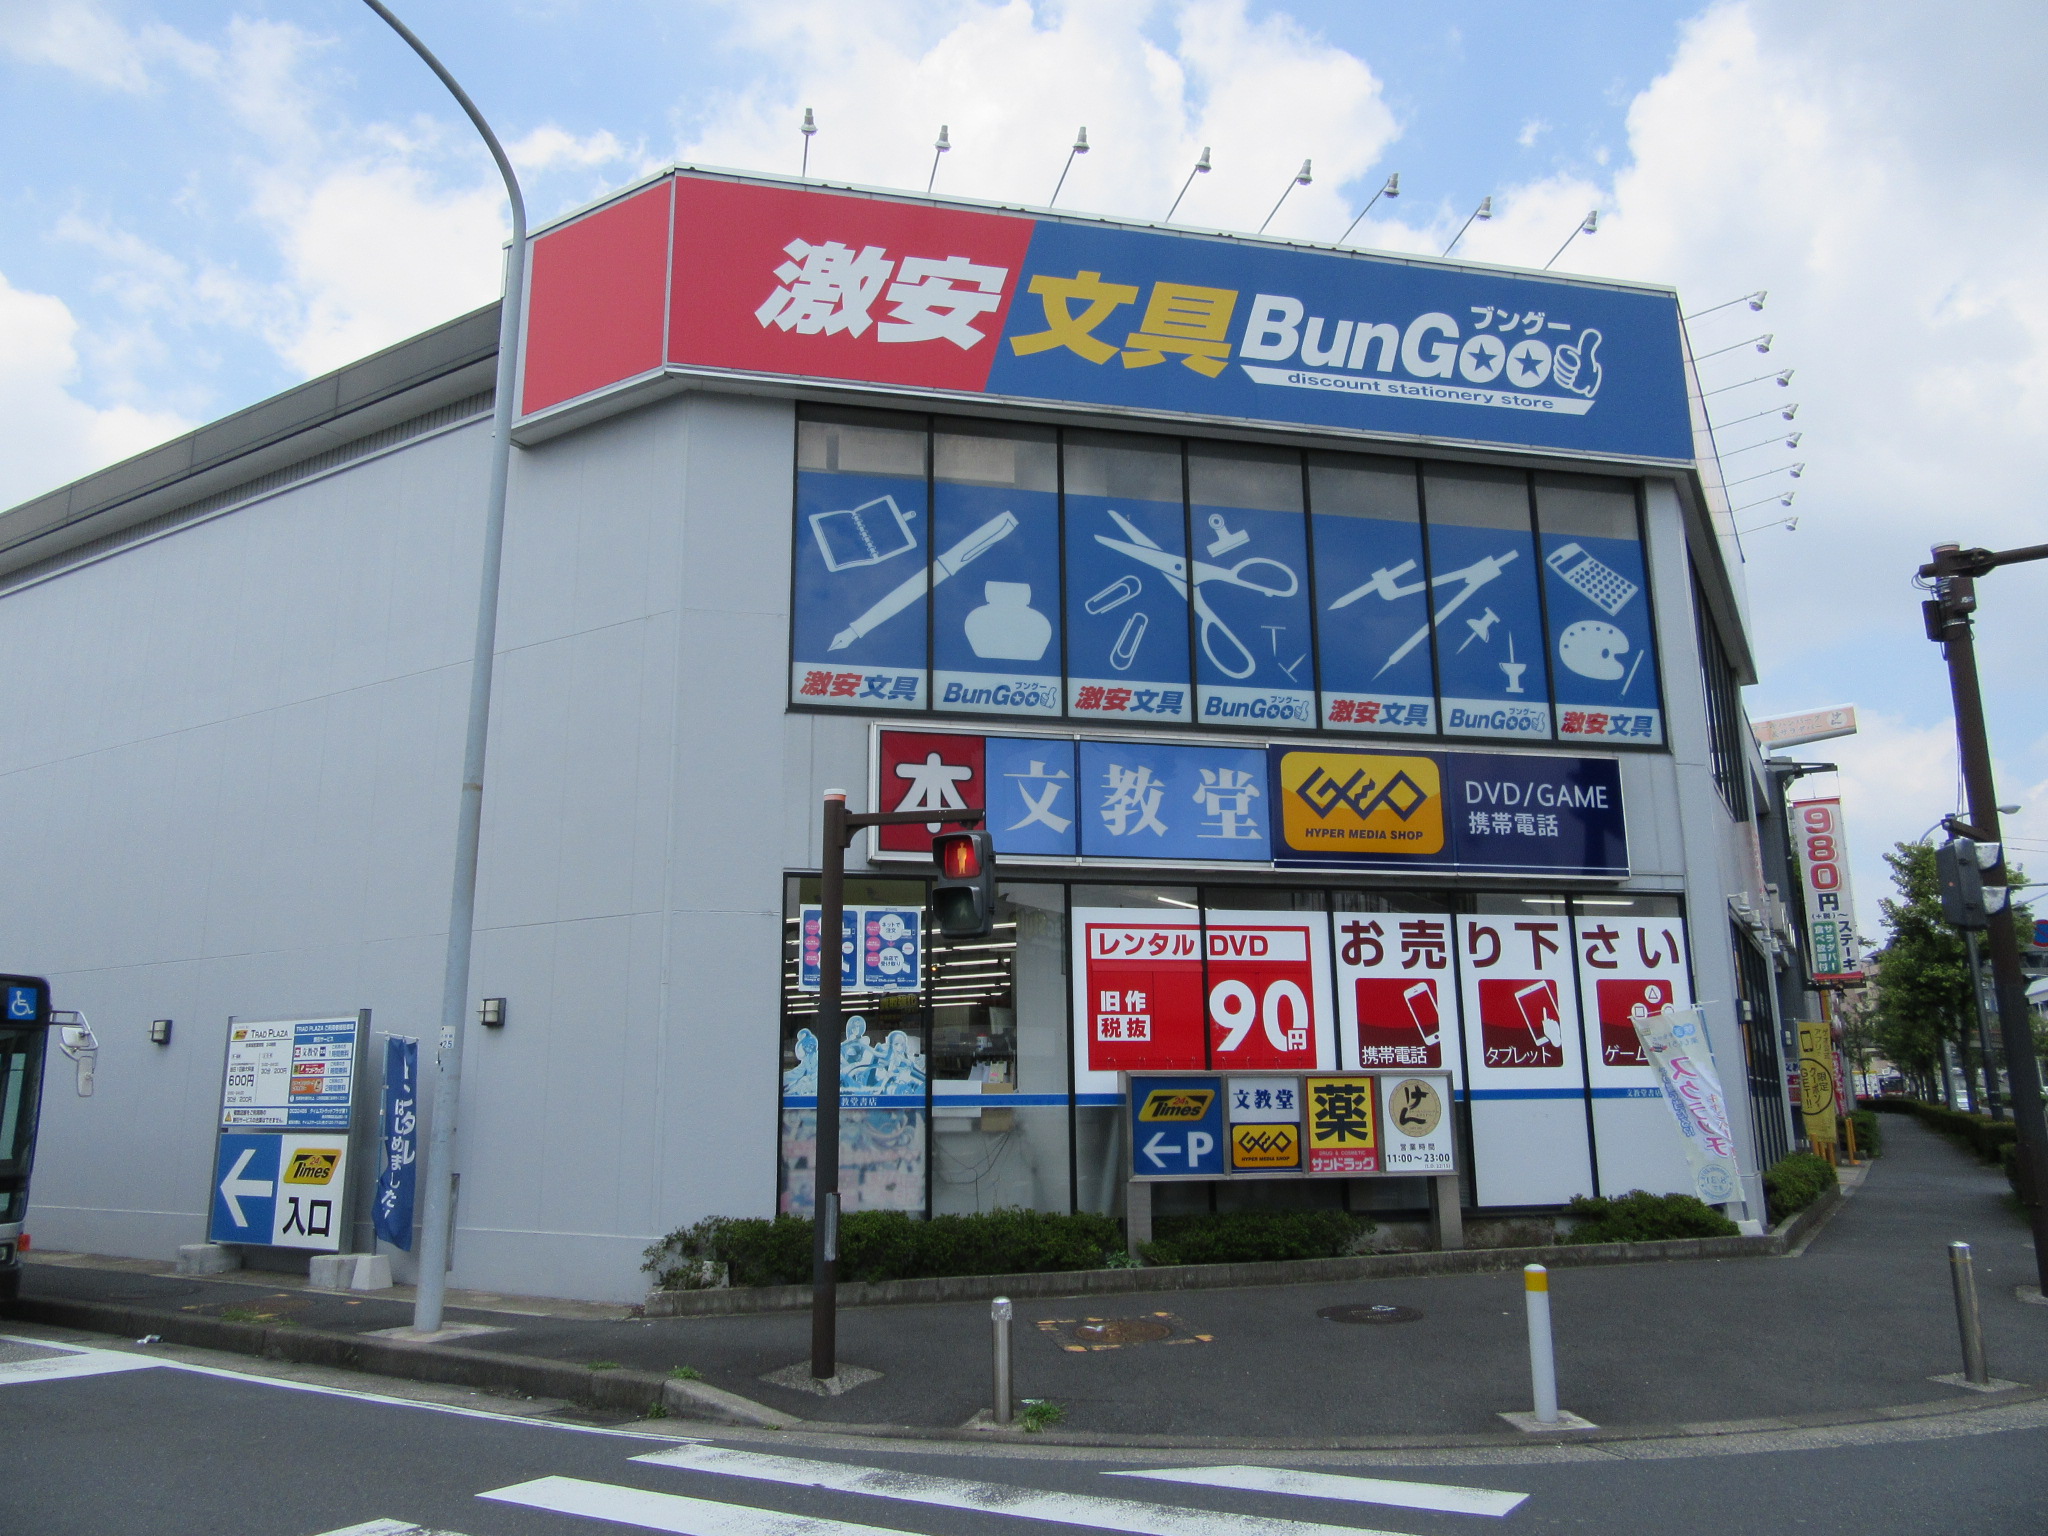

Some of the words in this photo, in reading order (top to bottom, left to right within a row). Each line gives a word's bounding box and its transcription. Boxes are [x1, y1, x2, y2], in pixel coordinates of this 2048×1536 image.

[755, 237, 1239, 378] 激安文具
[1471, 305, 1571, 335] ブングー
[1239, 294, 1552, 388] BunGoo
[1287, 372, 1381, 392] discount
[1388, 383, 1495, 404] stationery
[1501, 393, 1554, 409] store
[800, 670, 919, 701] 激安文具
[943, 682, 1040, 707] BunGoo
[1015, 682, 1048, 690] ブングー
[1075, 686, 1184, 715] 激安文具
[1204, 697, 1294, 721] BunGoo
[1328, 699, 1430, 727] 激安文具
[1449, 708, 1532, 733] BunGoo
[1560, 711, 1653, 738] 激安文具
[895, 752, 973, 834] 本
[1003, 760, 1262, 840] 文教堂
[1465, 780, 1609, 809] DVD/GAME
[1305, 828, 1345, 839] HYPER
[1349, 829, 1387, 839] MEDIA
[1390, 830, 1424, 840] SHOP
[1468, 812, 1559, 837] 携帯電話
[1099, 932, 1195, 956] レンタル
[1209, 934, 1269, 957] DVD
[1340, 918, 1680, 971] お売り下さい
[1838, 920, 1857, 971] ステーキ
[1100, 990, 1147, 1012] 旧作
[1101, 1017, 1147, 1038] 税抜
[1361, 1045, 1428, 1064] 携帯電話
[1486, 1045, 1552, 1064] タブレット
[228, 1074, 255, 1087] 600円
[841, 1096, 878, 1107] 教堂書店
[1150, 1097, 1203, 1118] Times
[1233, 1088, 1294, 1110] 文教堂
[1400, 1085, 1429, 1126] けん
[1313, 1084, 1368, 1142] 薬
[1187, 1131, 1214, 1168] P
[1400, 1143, 1435, 1151] 営業時間
[293, 1155, 331, 1178] Times
[1312, 1156, 1375, 1171] サンドラッグ
[282, 1196, 333, 1237] 入口
